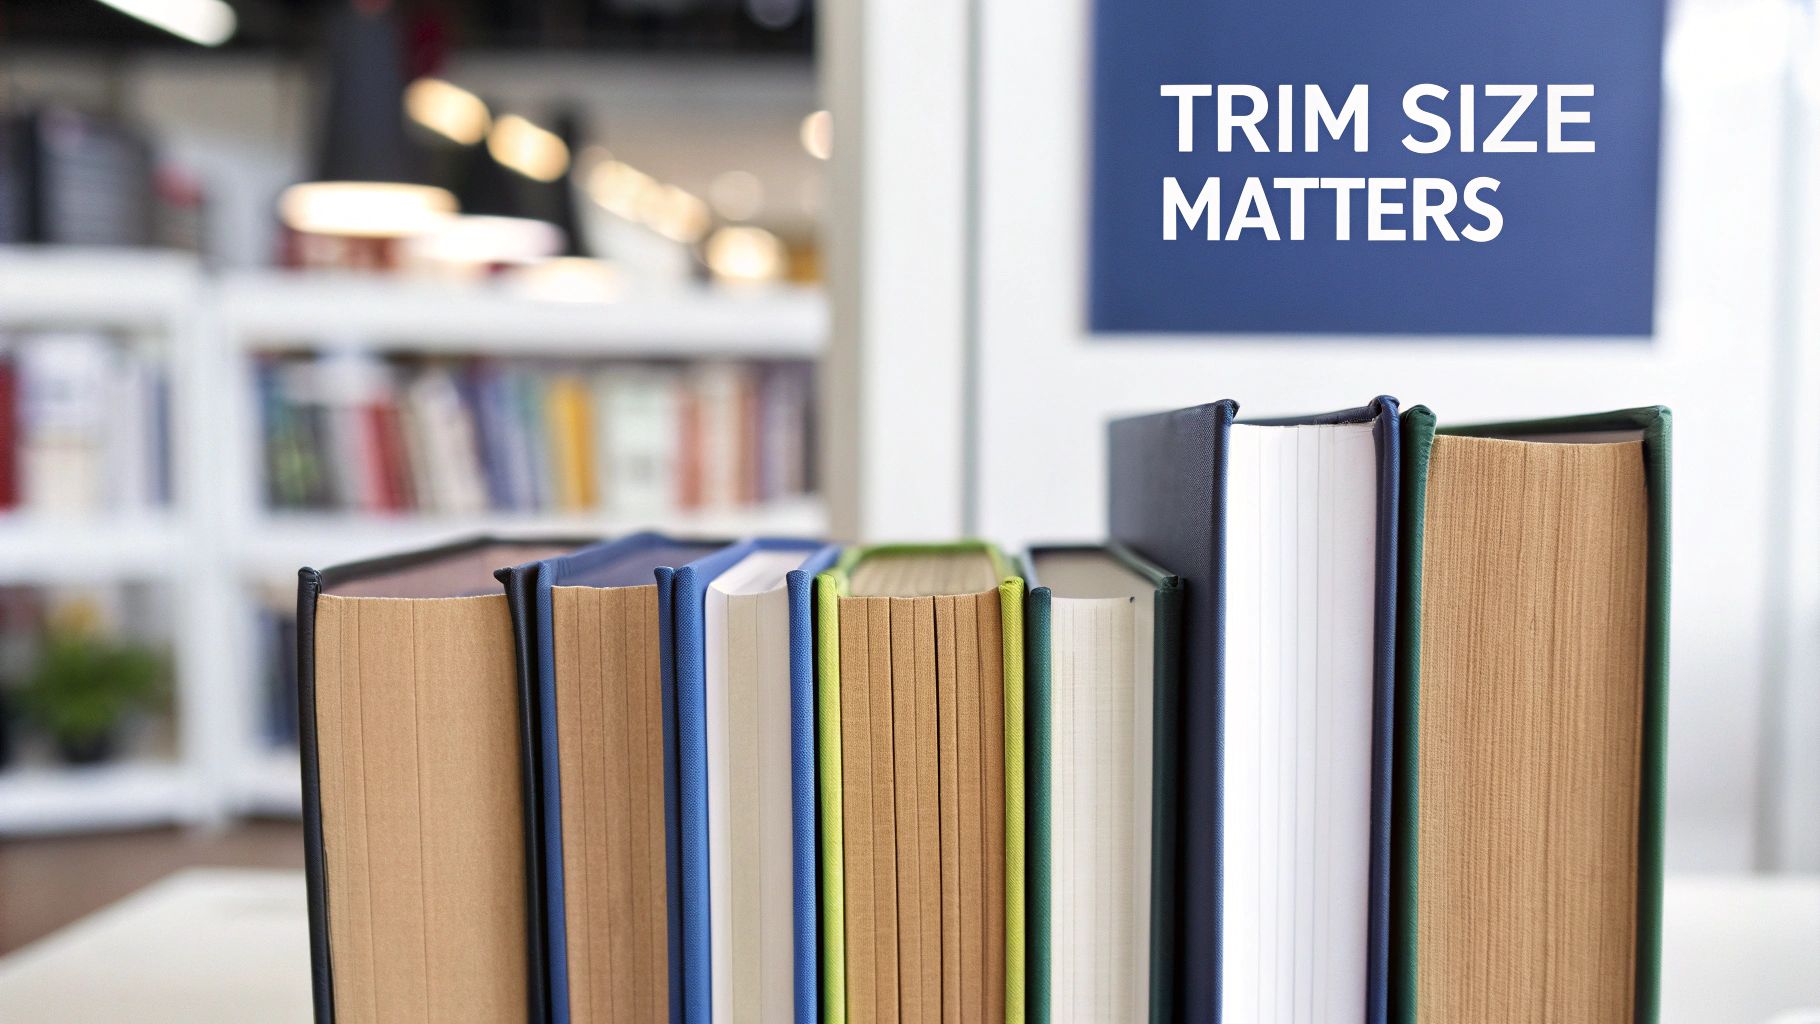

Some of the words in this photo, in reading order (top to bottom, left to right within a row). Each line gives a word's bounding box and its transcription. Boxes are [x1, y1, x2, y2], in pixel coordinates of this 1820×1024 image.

[1160, 84, 1369, 153] TRIM
[1401, 83, 1596, 154] SIZE
[1162, 176, 1504, 243] MATTERS
